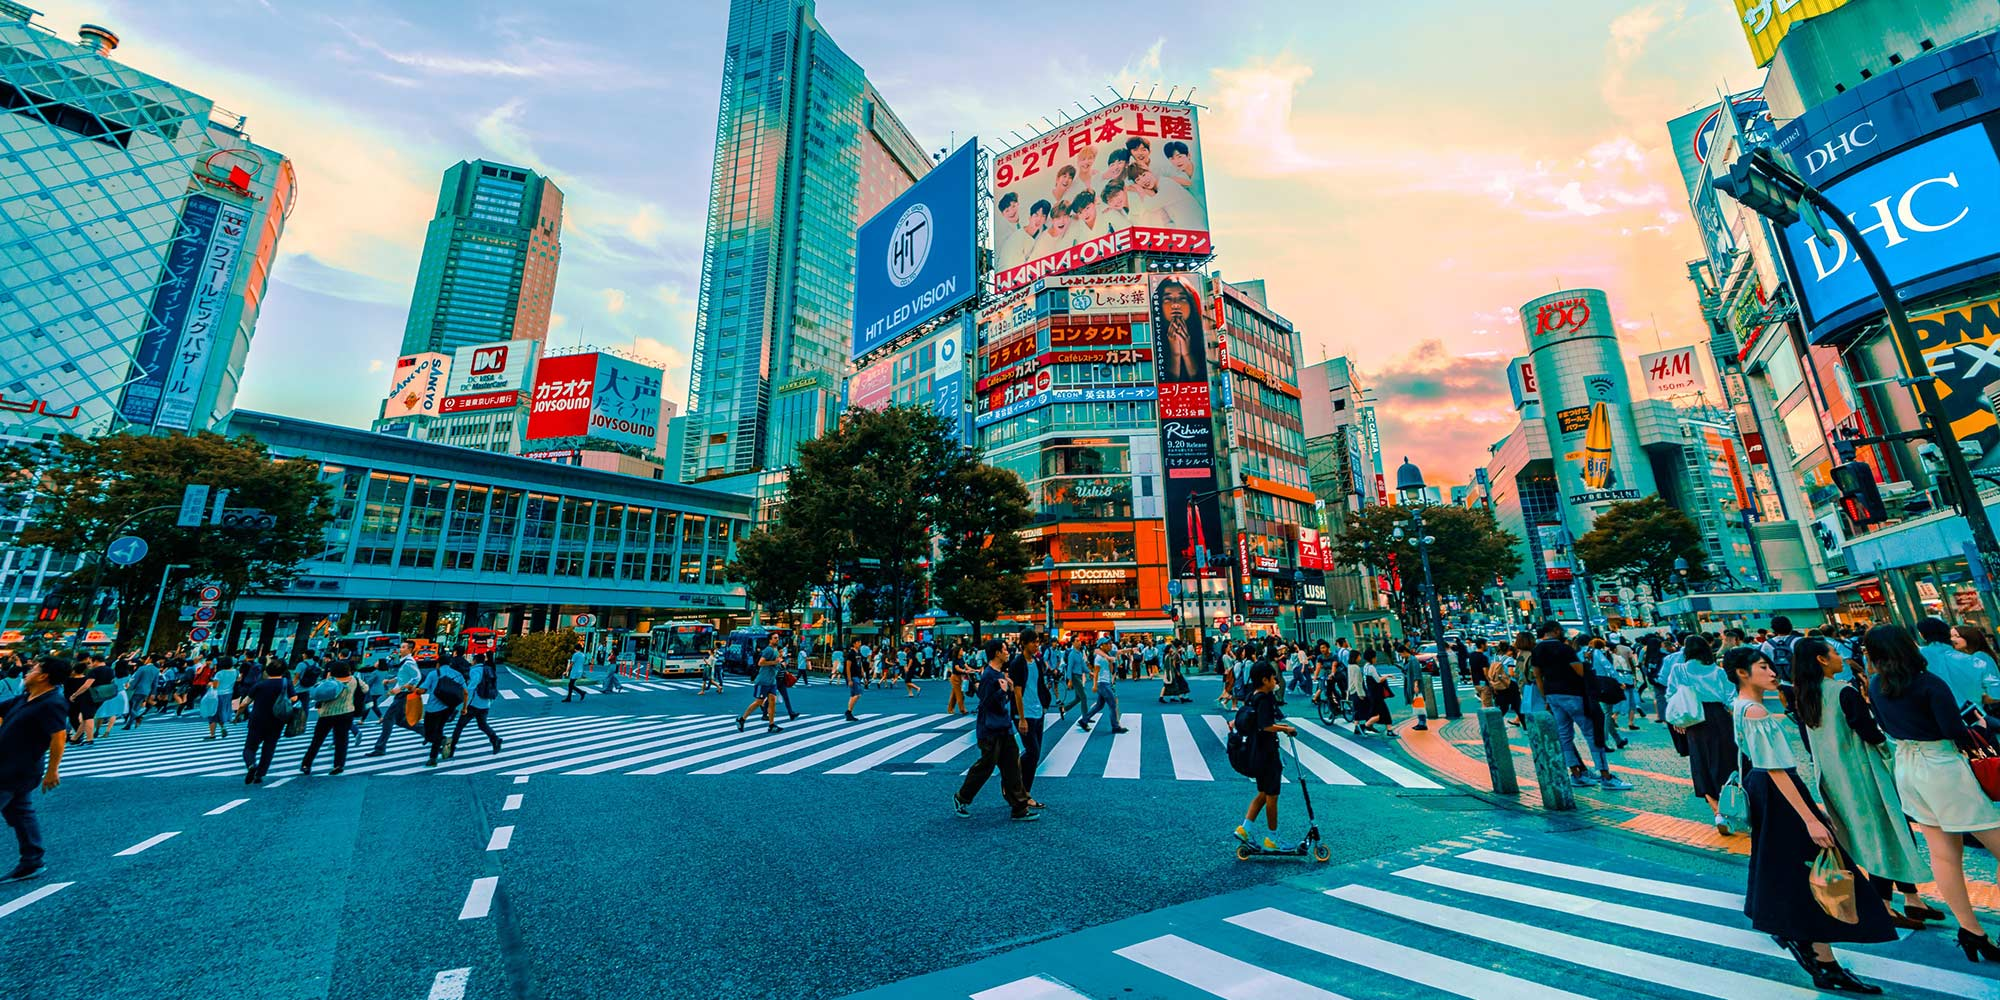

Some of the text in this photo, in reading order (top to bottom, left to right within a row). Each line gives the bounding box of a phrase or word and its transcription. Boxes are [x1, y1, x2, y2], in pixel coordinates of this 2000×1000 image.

[996, 112, 1193, 188] 9.27 日本上陸
[1803, 120, 1878, 174] DHC
[1803, 171, 1969, 282] DHC
[1134, 231, 1206, 252] ワナワン
[1060, 274, 1142, 286] しゃぶしゃぶバイキング
[1096, 290, 1145, 306] しゃぶ葉
[866, 318, 885, 343] HIT
[886, 303, 910, 331] LED
[912, 276, 957, 316] VISION
[1535, 303, 1590, 336] 109
[1051, 326, 1129, 342] コンタクト
[473, 349, 504, 373] DC
[1106, 350, 1144, 364] ガスト
[1650, 351, 1691, 381] H&M
[389, 360, 429, 399] SANKYO
[1015, 360, 1040, 378] ガスト
[423, 358, 444, 411] SANKYO
[536, 379, 592, 402] カラオケ
[598, 366, 660, 402] 大声
[1004, 380, 1034, 406] ガスト
[1085, 388, 1155, 400] 英会話イーオン
[1160, 383, 1208, 396] ユリゴコロ
[532, 397, 590, 414] JOYSOUND
[591, 413, 655, 438] JOYSOUND
[1163, 421, 1209, 439] Rihwa
[1167, 440, 1185, 449] 9.20
[1570, 490, 1640, 504] MAYBELLINE
[1071, 568, 1126, 580] L'OCCITANE
[1303, 584, 1326, 600] LUSH
